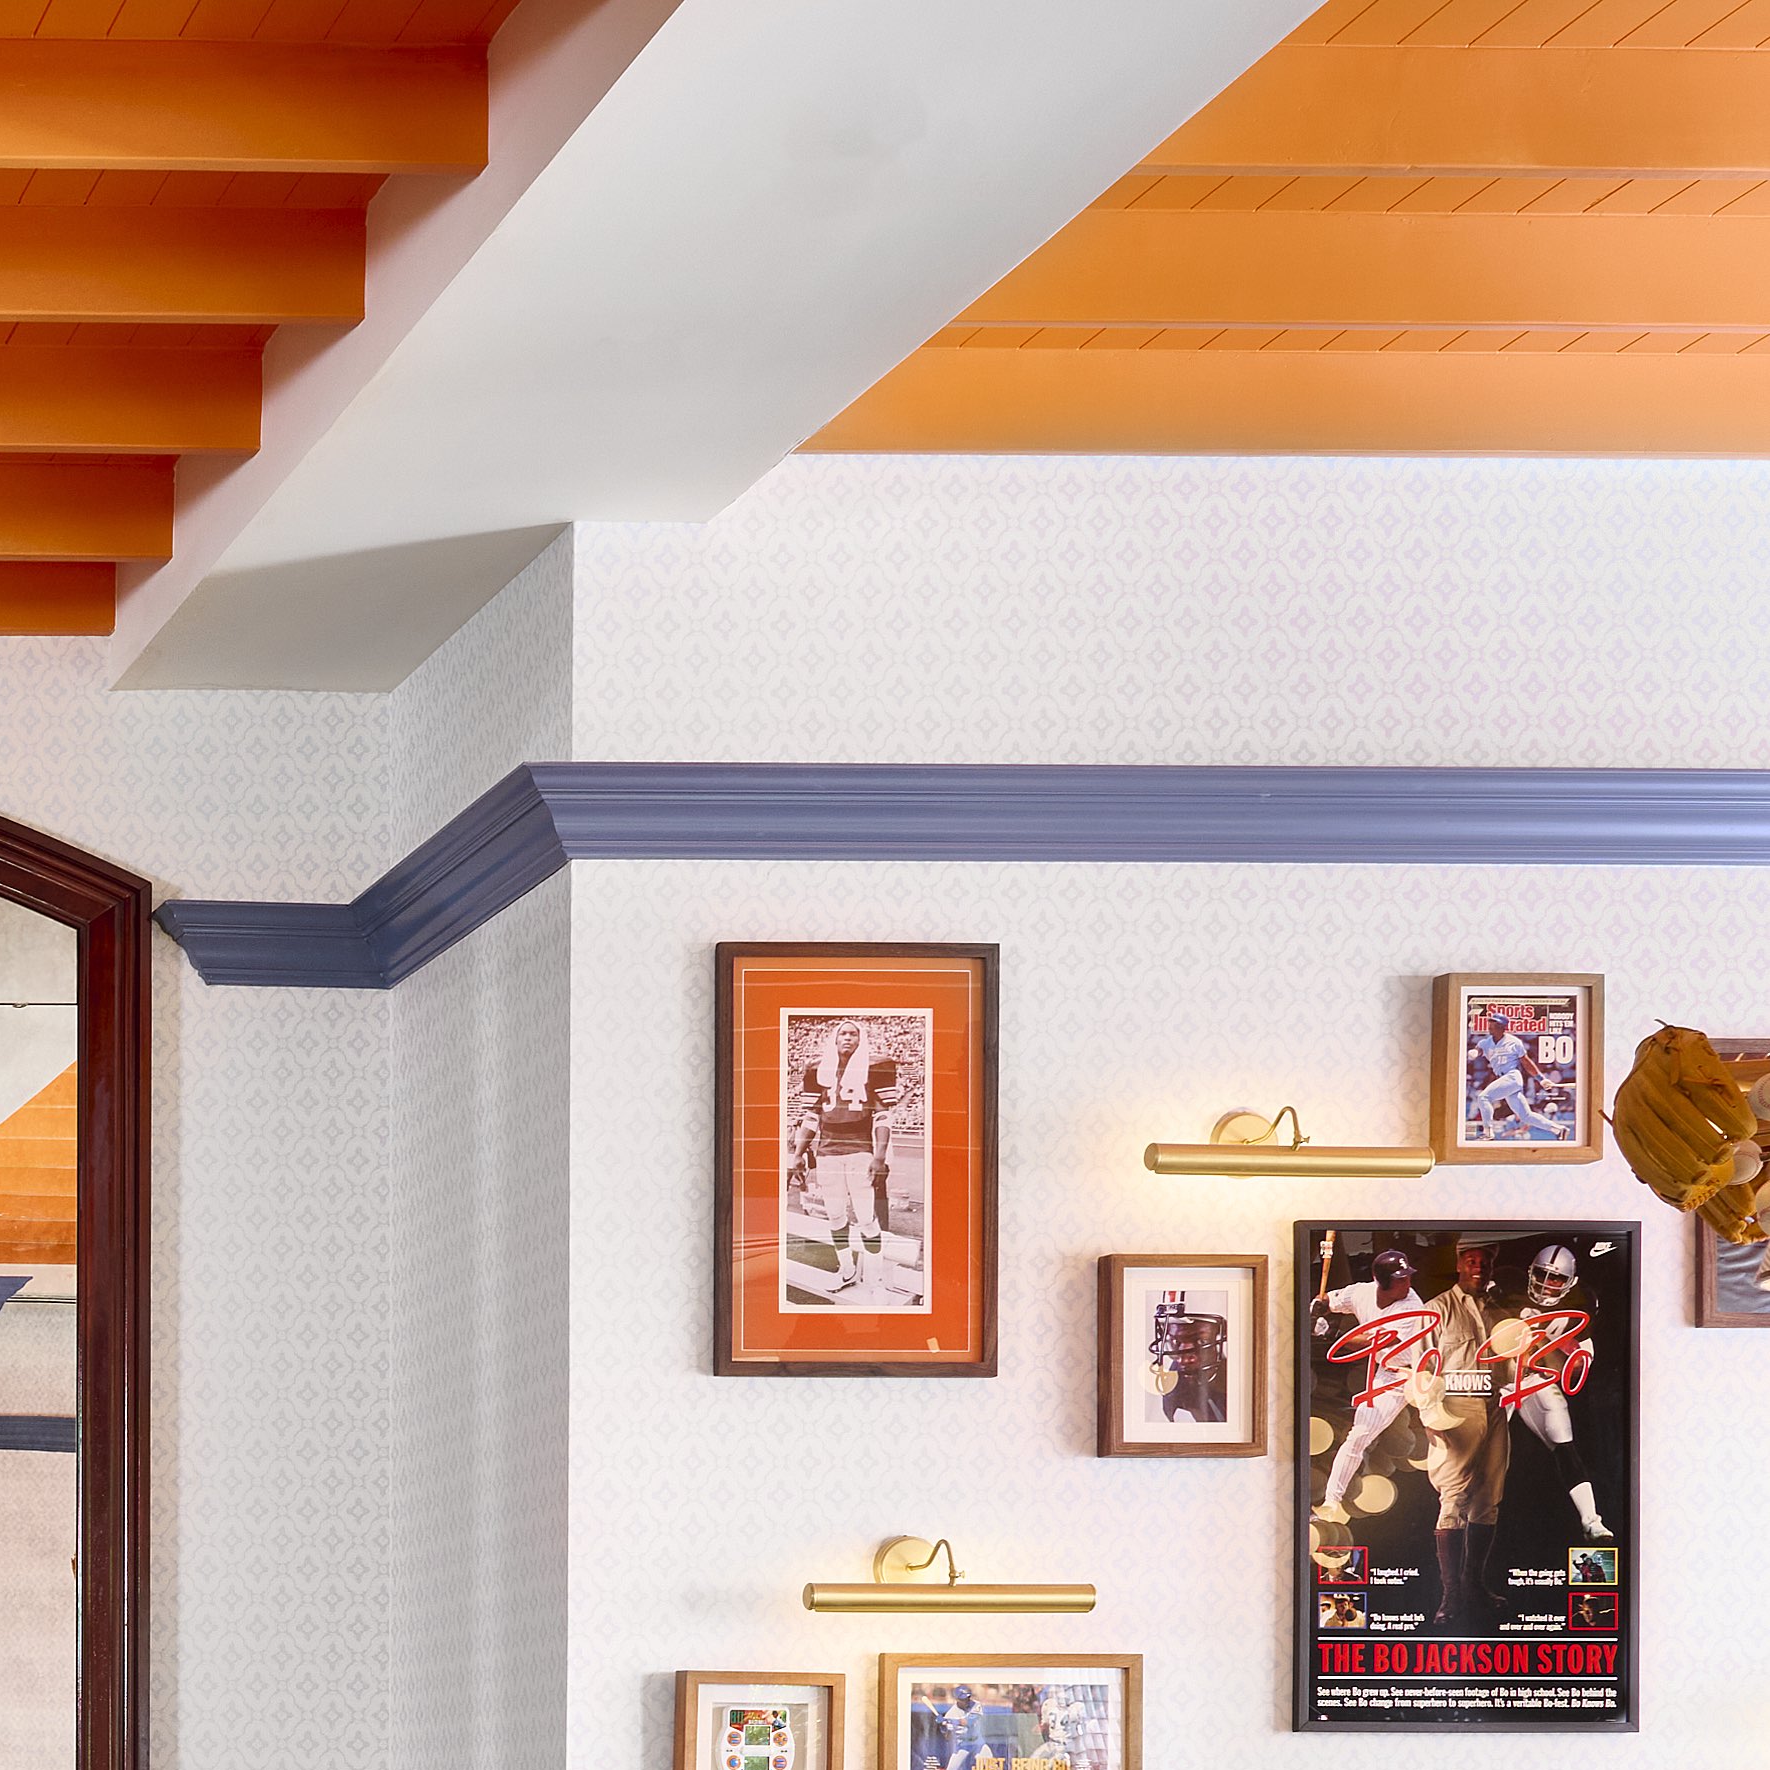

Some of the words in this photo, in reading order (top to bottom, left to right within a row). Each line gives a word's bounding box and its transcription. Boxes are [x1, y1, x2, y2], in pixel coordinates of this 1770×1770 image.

[1487, 1003, 1535, 1019] Sports
[1473, 1013, 1547, 1033] Illrated
[1538, 1035, 1575, 1065] BO
[1327, 1310, 1441, 1408] Bo
[1445, 1373, 1492, 1392] KNOWS
[1476, 1310, 1591, 1409] Bo
[1317, 1643, 1365, 1674] THE
[1374, 1643, 1408, 1674] BO
[1413, 1643, 1529, 1674] JACKSON
[1537, 1643, 1618, 1674] STORY
[1317, 1687, 1330, 1697] See
[1352, 1687, 1361, 1697] Bo
[1391, 1687, 1403, 1697] See
[1491, 1687, 1498, 1697] of
[1500, 1687, 1509, 1697] Bo
[1571, 1687, 1580, 1697] Bo
[1582, 1687, 1604, 1697] behind
[1605, 1687, 1617, 1697] the
[1358, 1698, 1368, 1707] Bo
[1395, 1698, 1411, 1707] from
[1448, 1698, 1456, 1707] to
